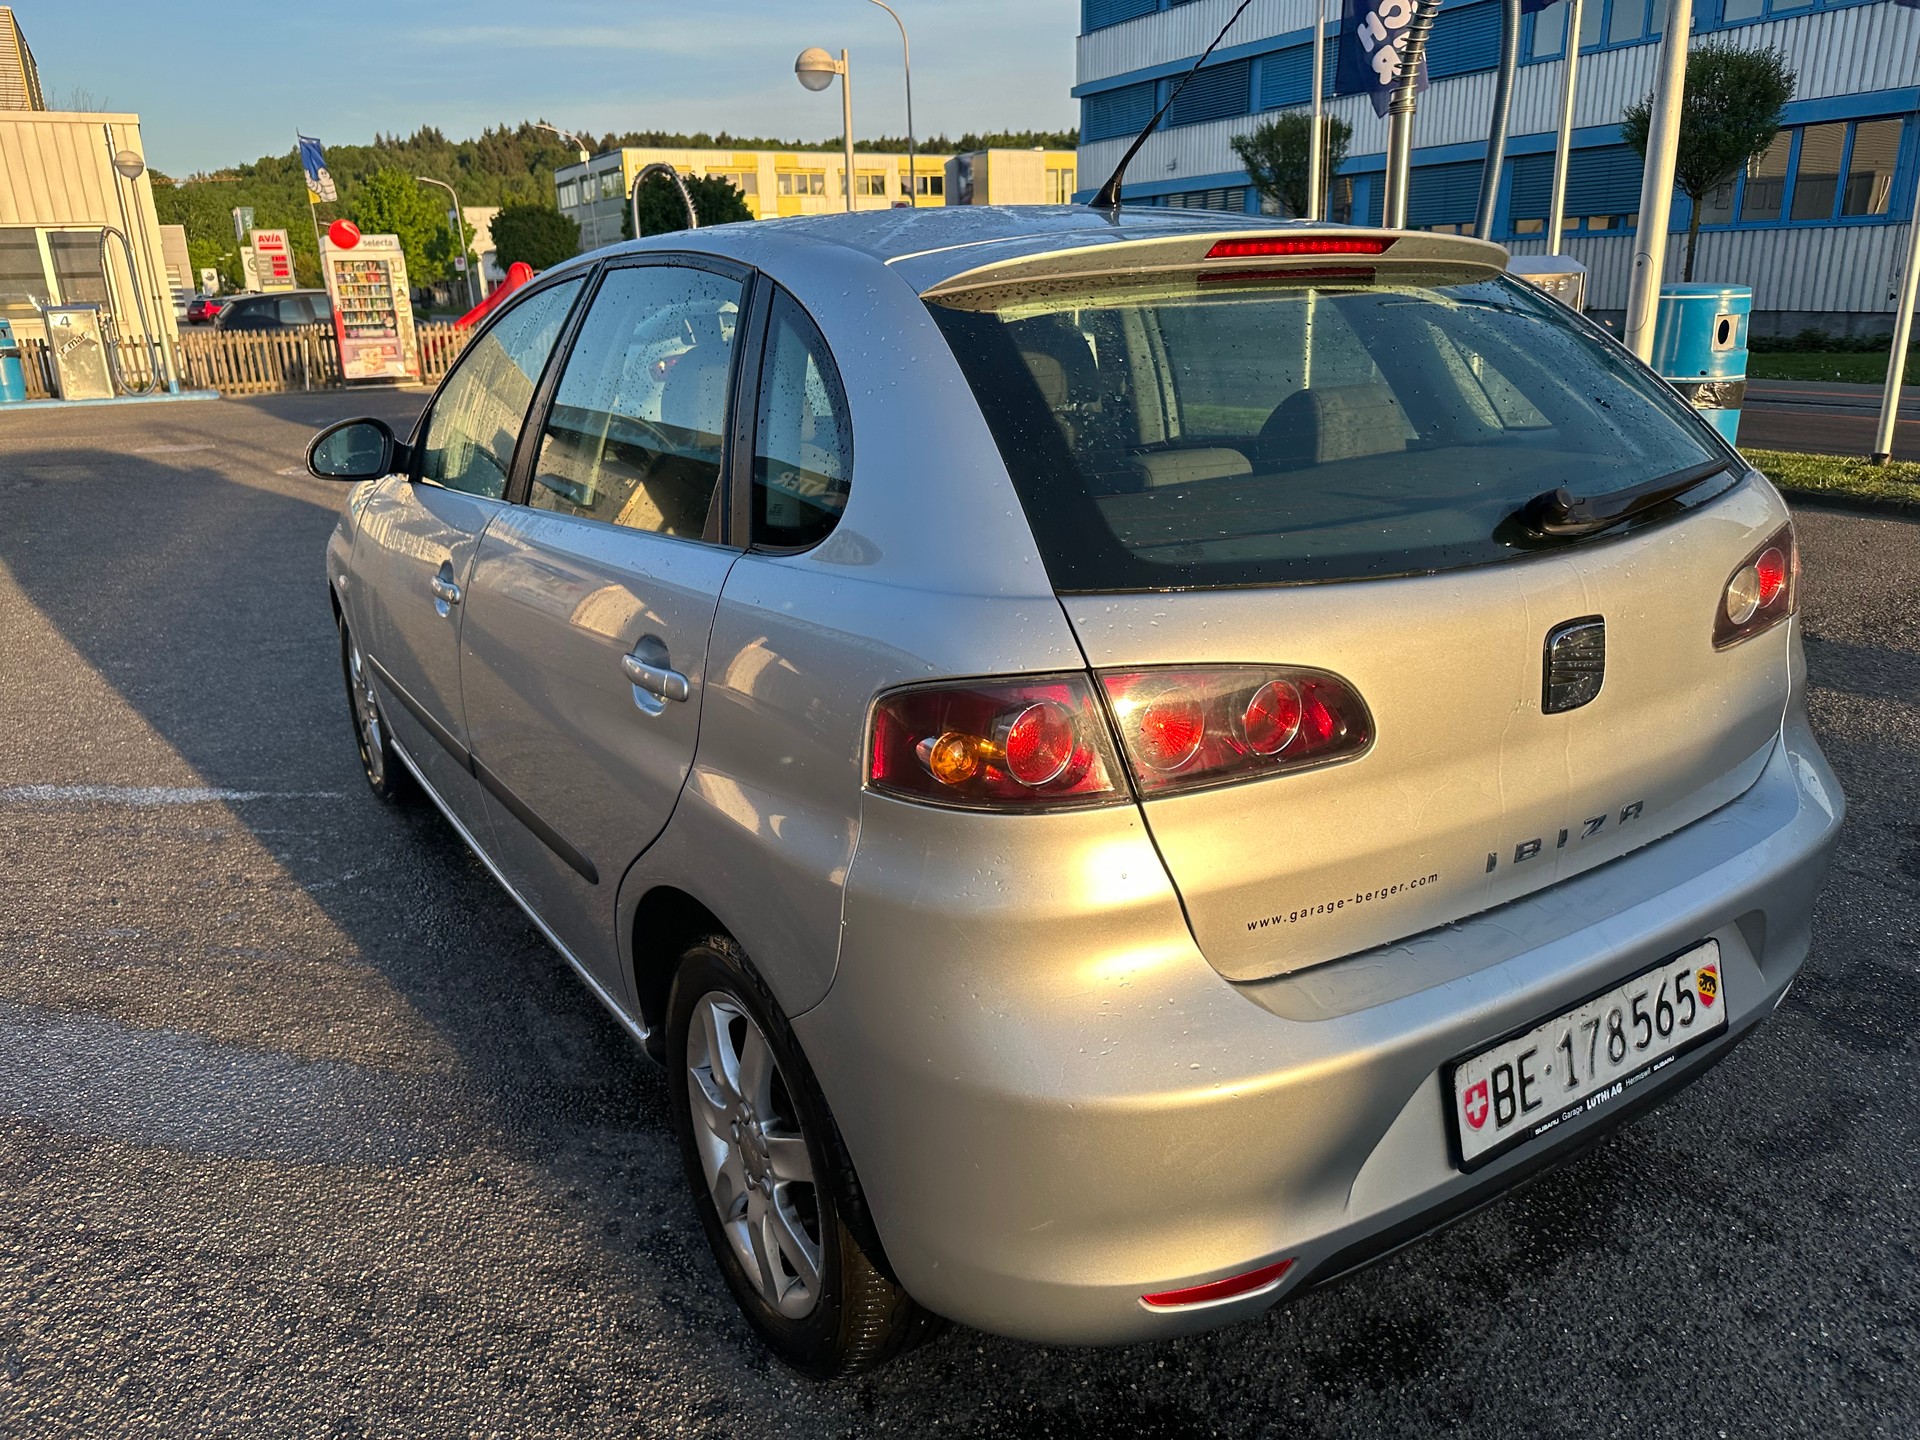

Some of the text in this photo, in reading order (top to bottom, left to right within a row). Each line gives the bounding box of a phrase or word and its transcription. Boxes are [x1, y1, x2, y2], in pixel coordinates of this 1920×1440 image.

[362, 237, 393, 247] selecta
[60, 316, 71, 328] 4
[1485, 801, 1643, 874] IBIZA
[1247, 873, 1439, 931] www.garage-berger.com
[1534, 1118, 1560, 1136] SUBARU
[1561, 1105, 1584, 1121] Garage
[1611, 1082, 1623, 1098] AG
[1653, 1055, 1675, 1071] SUBARU
